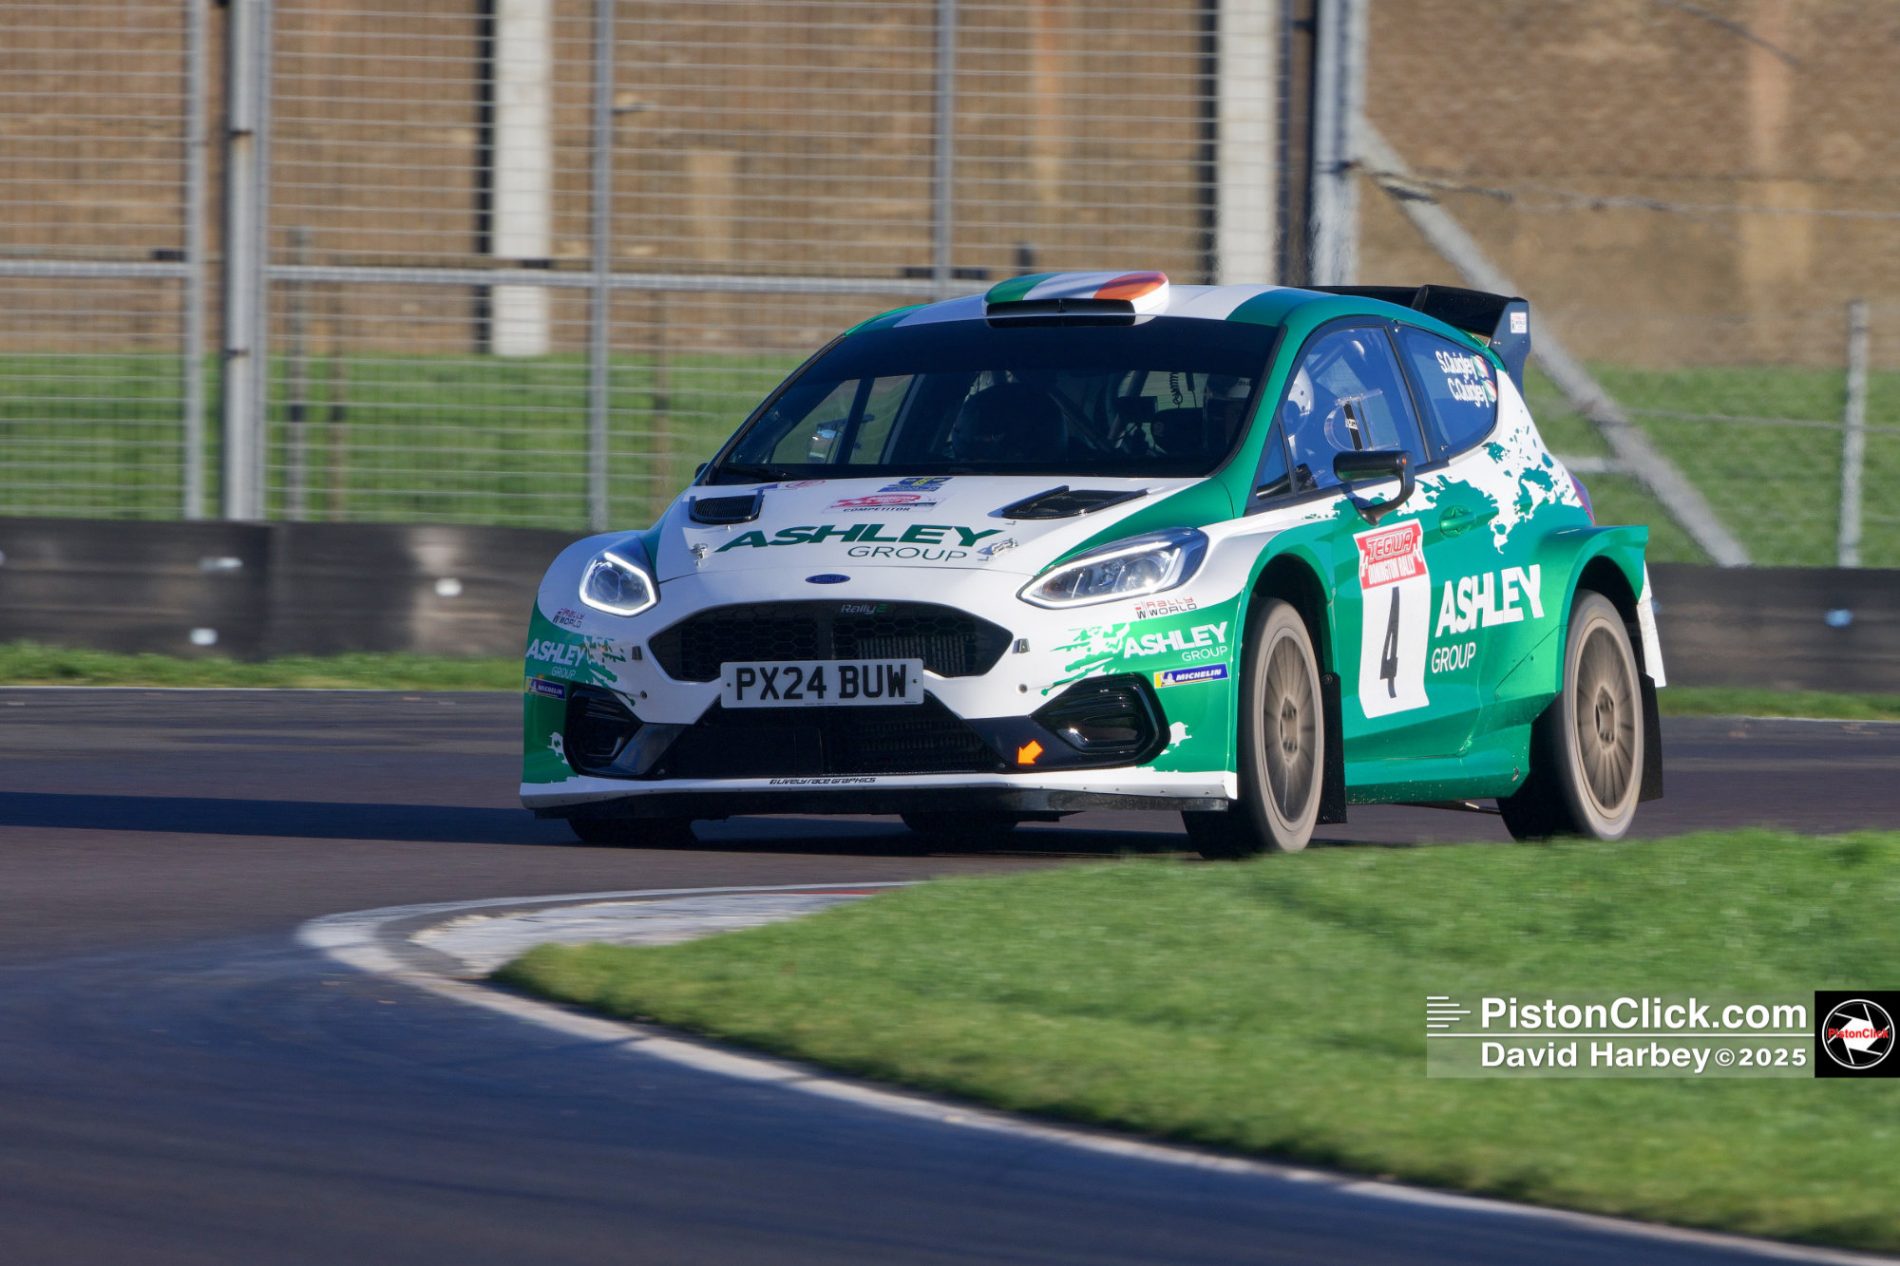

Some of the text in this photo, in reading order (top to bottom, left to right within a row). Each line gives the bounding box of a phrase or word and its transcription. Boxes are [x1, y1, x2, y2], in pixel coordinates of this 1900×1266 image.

[715, 523, 1005, 553] ASHLEY
[847, 546, 968, 562] GROUP
[1434, 564, 1545, 638] ASHLEY
[525, 638, 586, 667] ASHLEY
[1124, 621, 1228, 659] ASHLEY
[1182, 646, 1228, 662] GROUP
[1380, 586, 1400, 699] 4
[551, 666, 577, 678] GROUP
[1431, 642, 1477, 674] GROUP
[736, 664, 907, 701] PX24 BUW
[1175, 668, 1222, 682] MICHELIN
